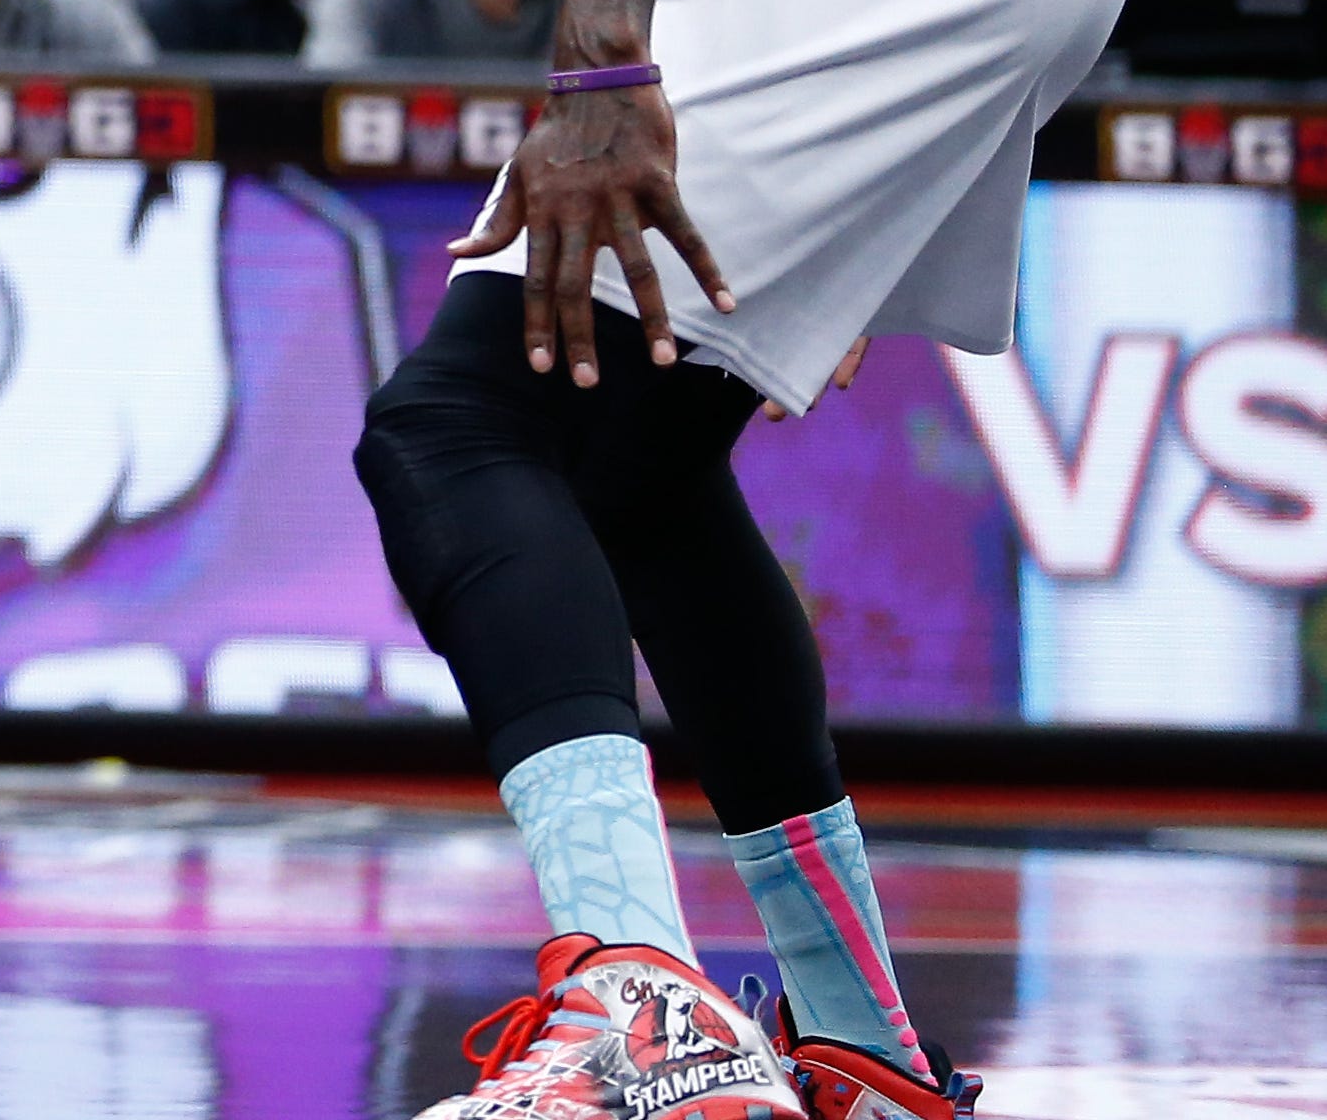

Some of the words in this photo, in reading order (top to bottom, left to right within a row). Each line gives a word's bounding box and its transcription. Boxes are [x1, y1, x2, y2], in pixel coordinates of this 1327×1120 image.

[338, 92, 547, 171] BIG
[942, 329, 1327, 588] VS
[623, 1054, 771, 1120] STAMPEDE
